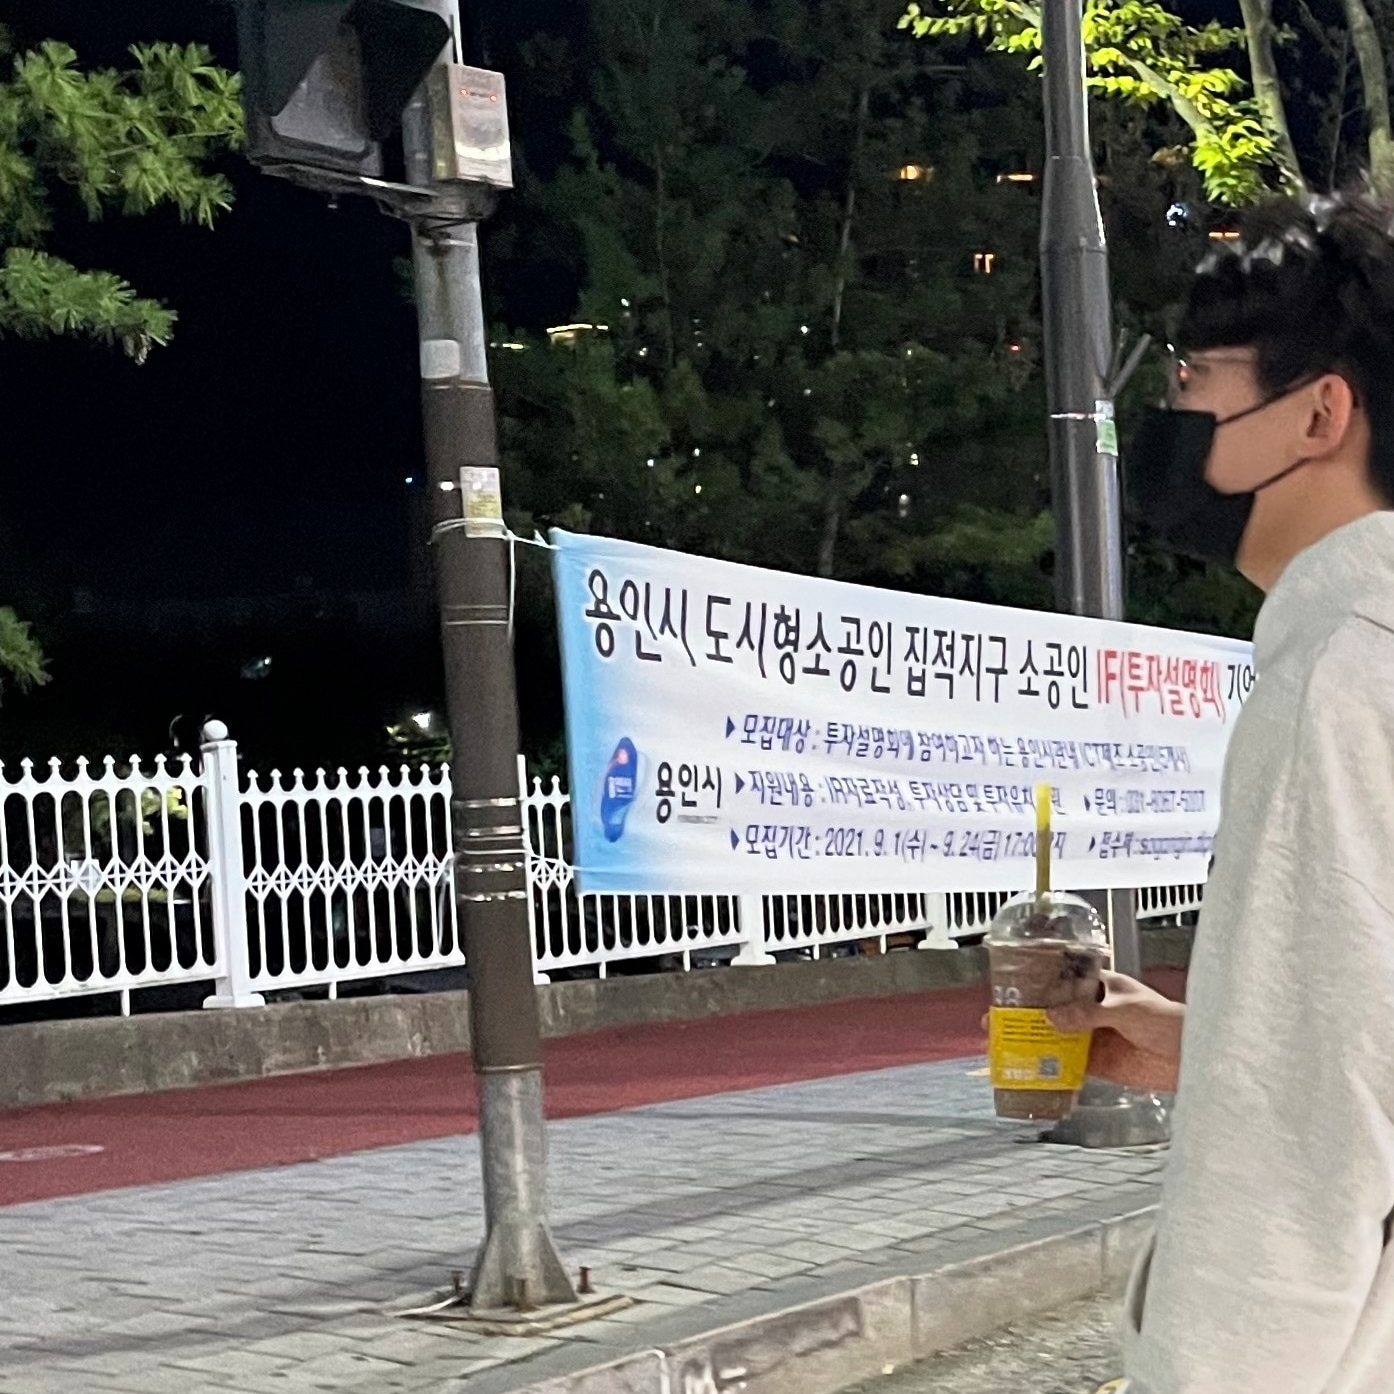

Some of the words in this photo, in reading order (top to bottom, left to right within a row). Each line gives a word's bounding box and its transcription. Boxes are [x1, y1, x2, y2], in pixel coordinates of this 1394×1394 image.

[585, 569, 696, 667] 용인시
[705, 594, 892, 694] 도시형소공인
[903, 626, 1008, 703] 집적지구
[1017, 639, 1089, 710] 소공인
[655, 761, 722, 824] 용인시
